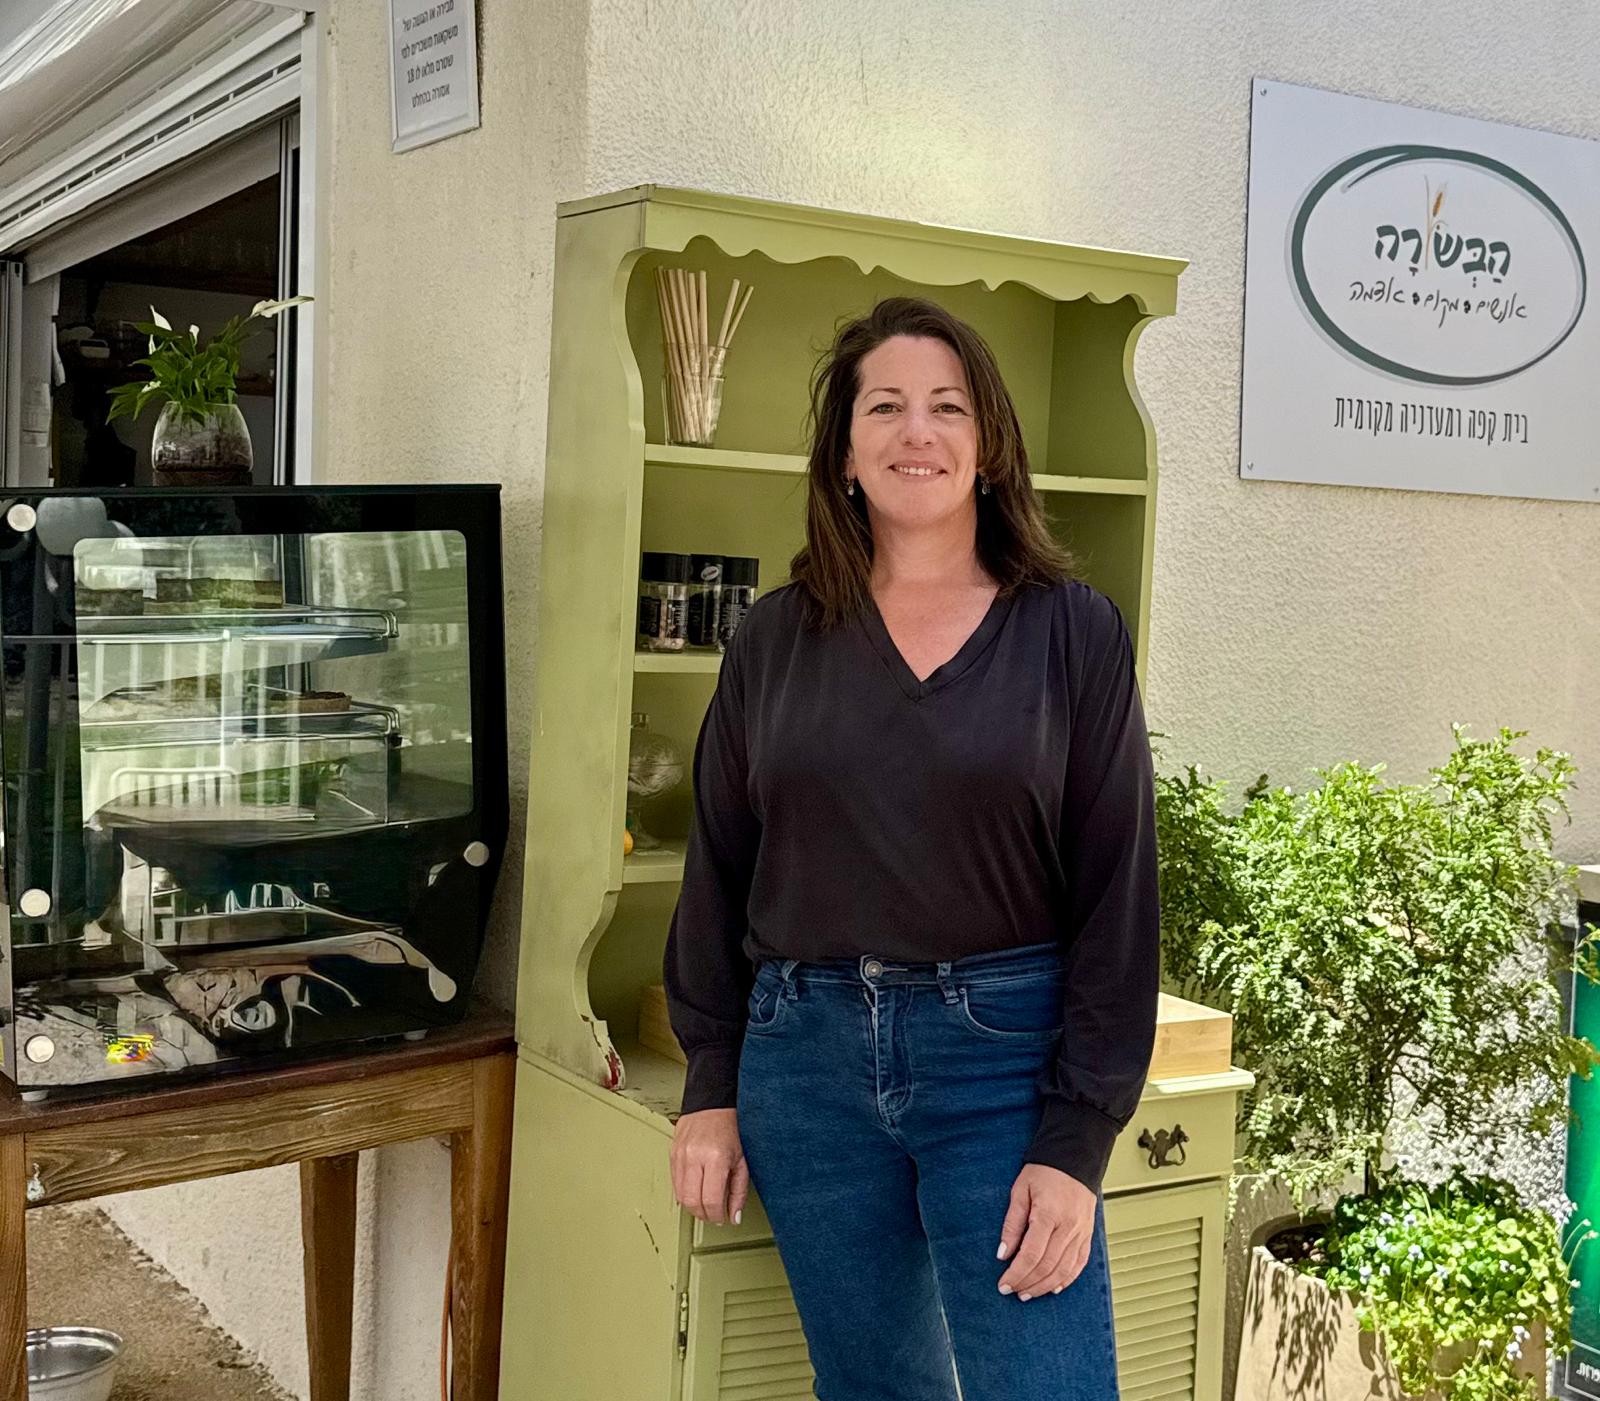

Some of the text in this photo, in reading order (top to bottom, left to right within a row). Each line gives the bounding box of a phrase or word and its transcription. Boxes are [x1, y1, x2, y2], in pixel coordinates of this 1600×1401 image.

[402, 18, 412, 32] של
[429, 8, 436, 20] או
[433, 24, 459, 46] משקאות
[401, 43, 411, 59] למי
[407, 54, 454, 84] שטרם מלאו לו 18
[411, 83, 450, 108] אסורה בהחלט
[1349, 276, 1528, 329] אנשים מקום אדמה
[1333, 397, 1529, 446] בית קפה ומעדניה מקומית
